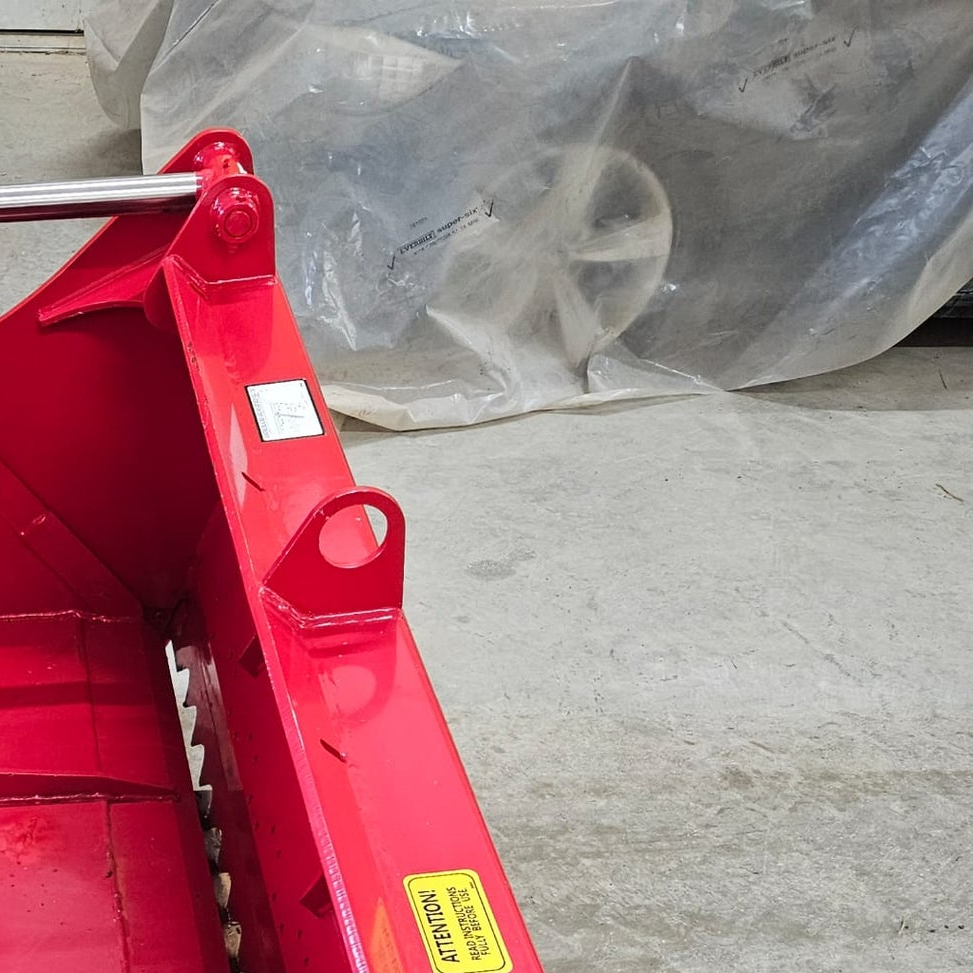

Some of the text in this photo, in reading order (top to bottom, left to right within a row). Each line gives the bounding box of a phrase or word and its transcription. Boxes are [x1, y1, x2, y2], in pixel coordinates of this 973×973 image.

[437, 207, 476, 232] super-six
[418, 890, 460, 962] ATTENTION!
[446, 886, 482, 960] READ INSTRUCTIONS
[458, 888, 491, 956] FULLY BEFORE USE
